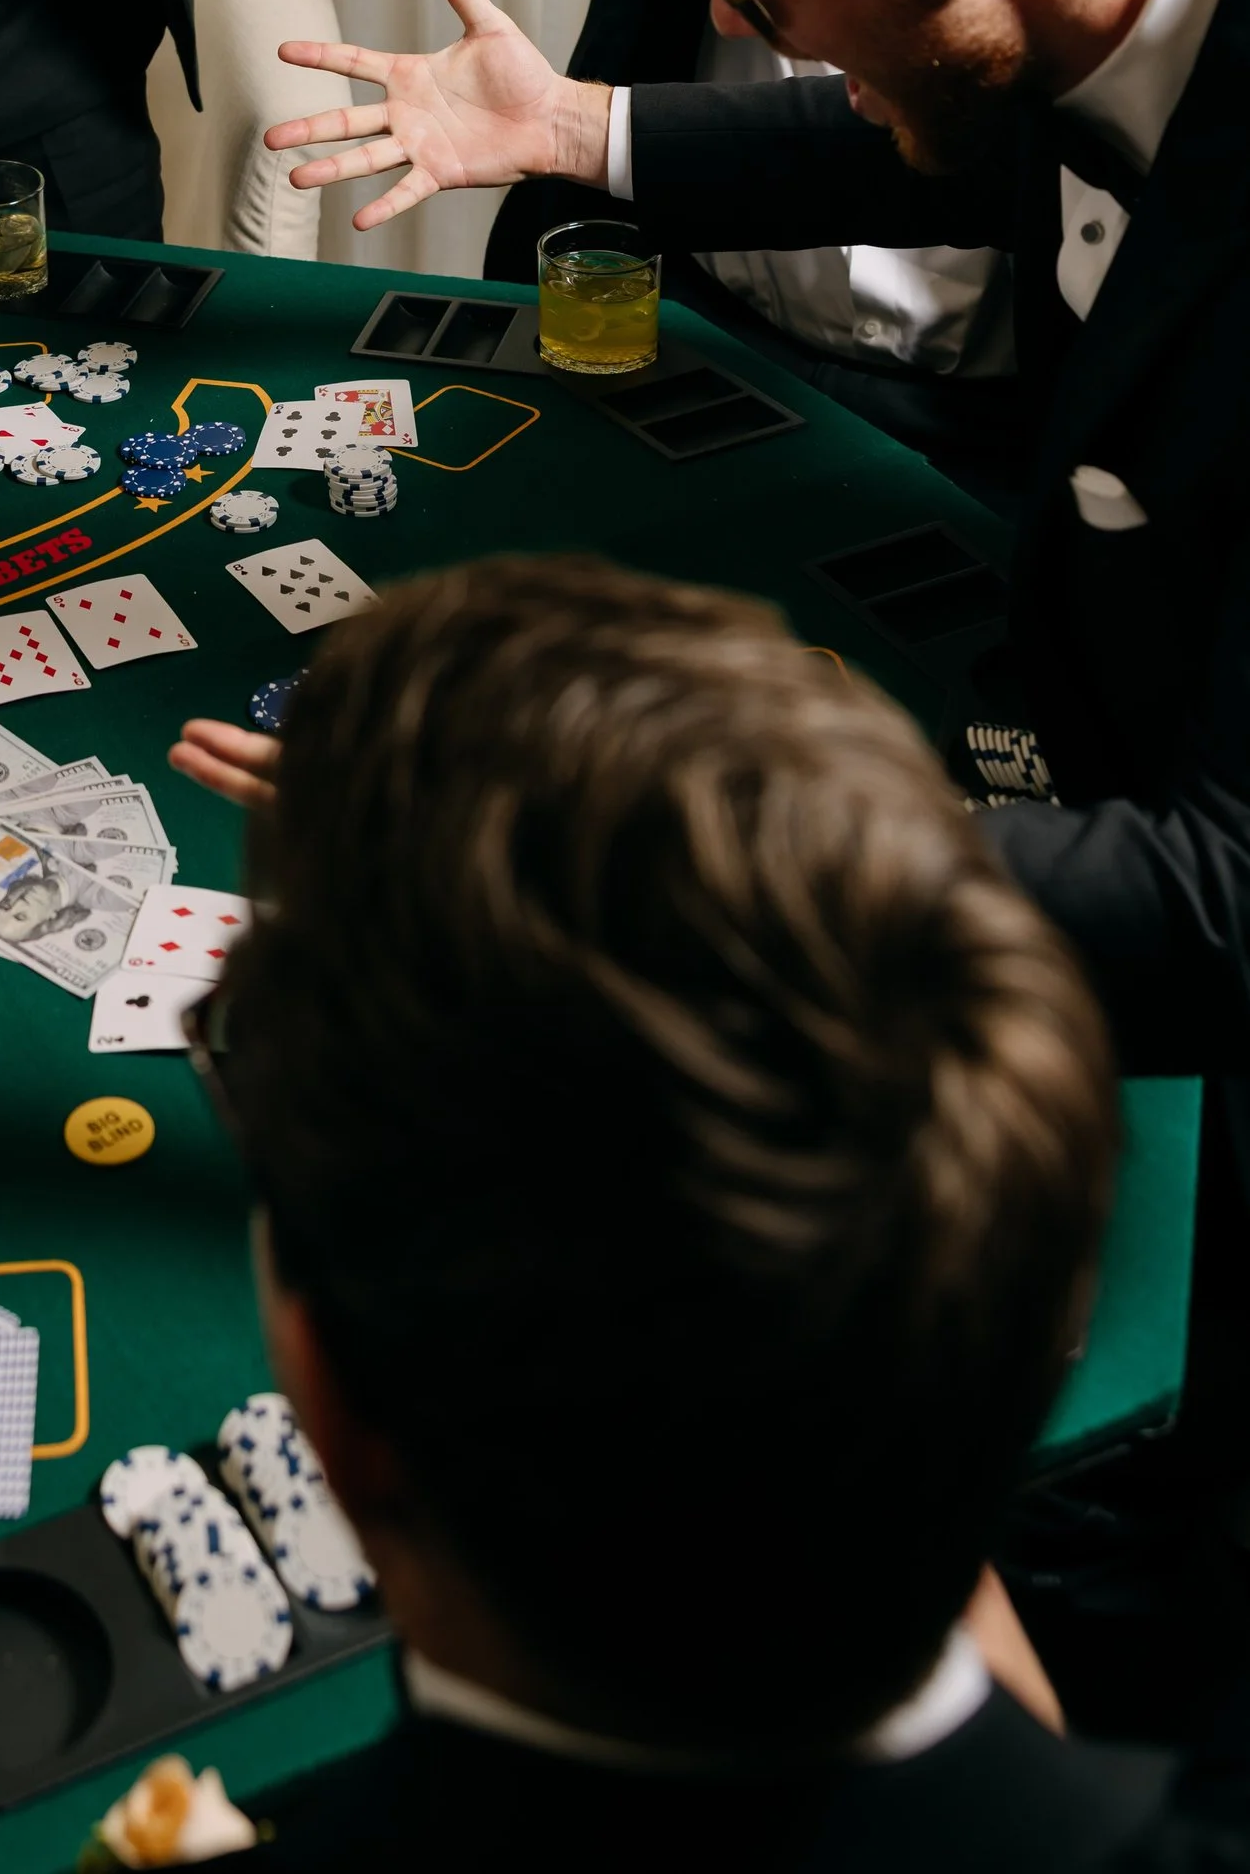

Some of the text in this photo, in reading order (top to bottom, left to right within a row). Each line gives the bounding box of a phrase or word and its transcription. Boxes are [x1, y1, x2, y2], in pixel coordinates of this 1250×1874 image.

[318, 386, 329, 394] K
[401, 436, 413, 445] K
[232, 563, 243, 572] 8
[53, 596, 64, 604] 5
[180, 638, 190, 646] 5
[74, 678, 85, 686] 9
[97, 1036, 113, 1045] 2
[86, 1111, 120, 1134] BIG
[87, 1118, 144, 1154] BLIND
